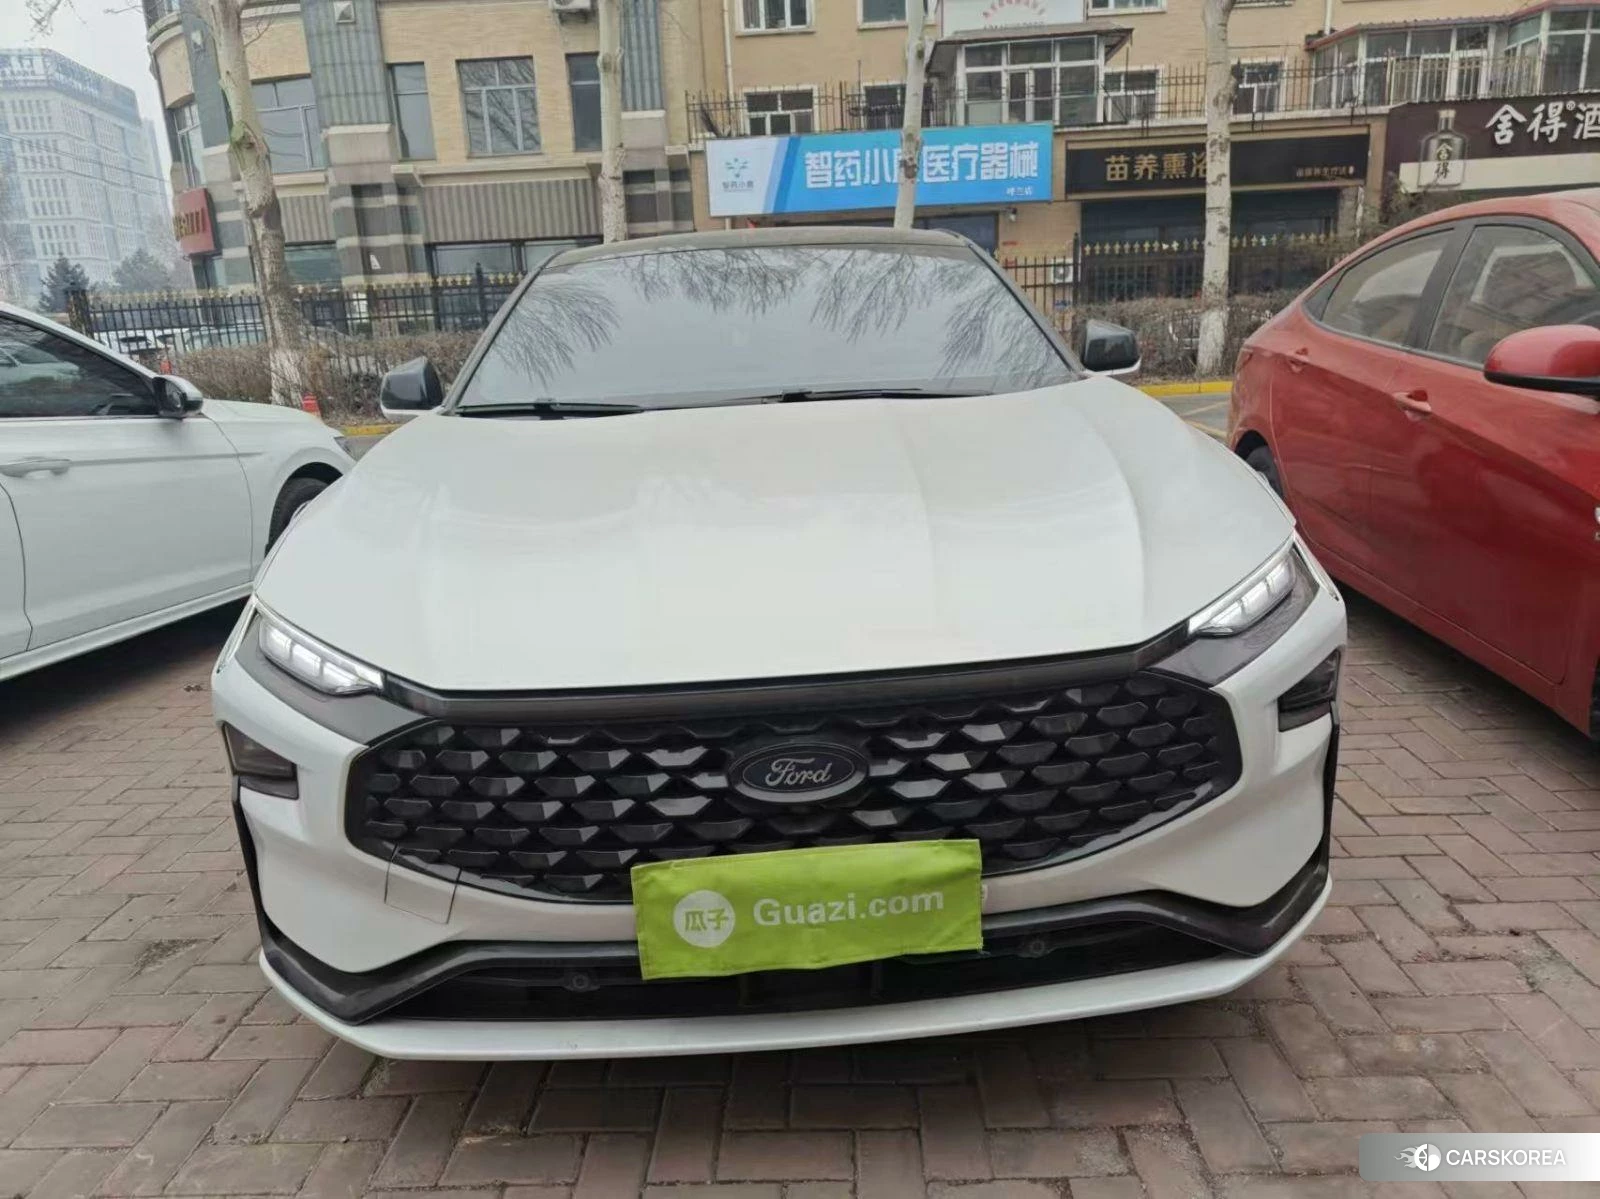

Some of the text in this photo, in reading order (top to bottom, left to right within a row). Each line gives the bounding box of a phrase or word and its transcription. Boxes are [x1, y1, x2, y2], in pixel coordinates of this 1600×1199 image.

[765, 757, 833, 786] Ford
[684, 909, 729, 932] 瓜子
[753, 889, 945, 926] Guazi.com
